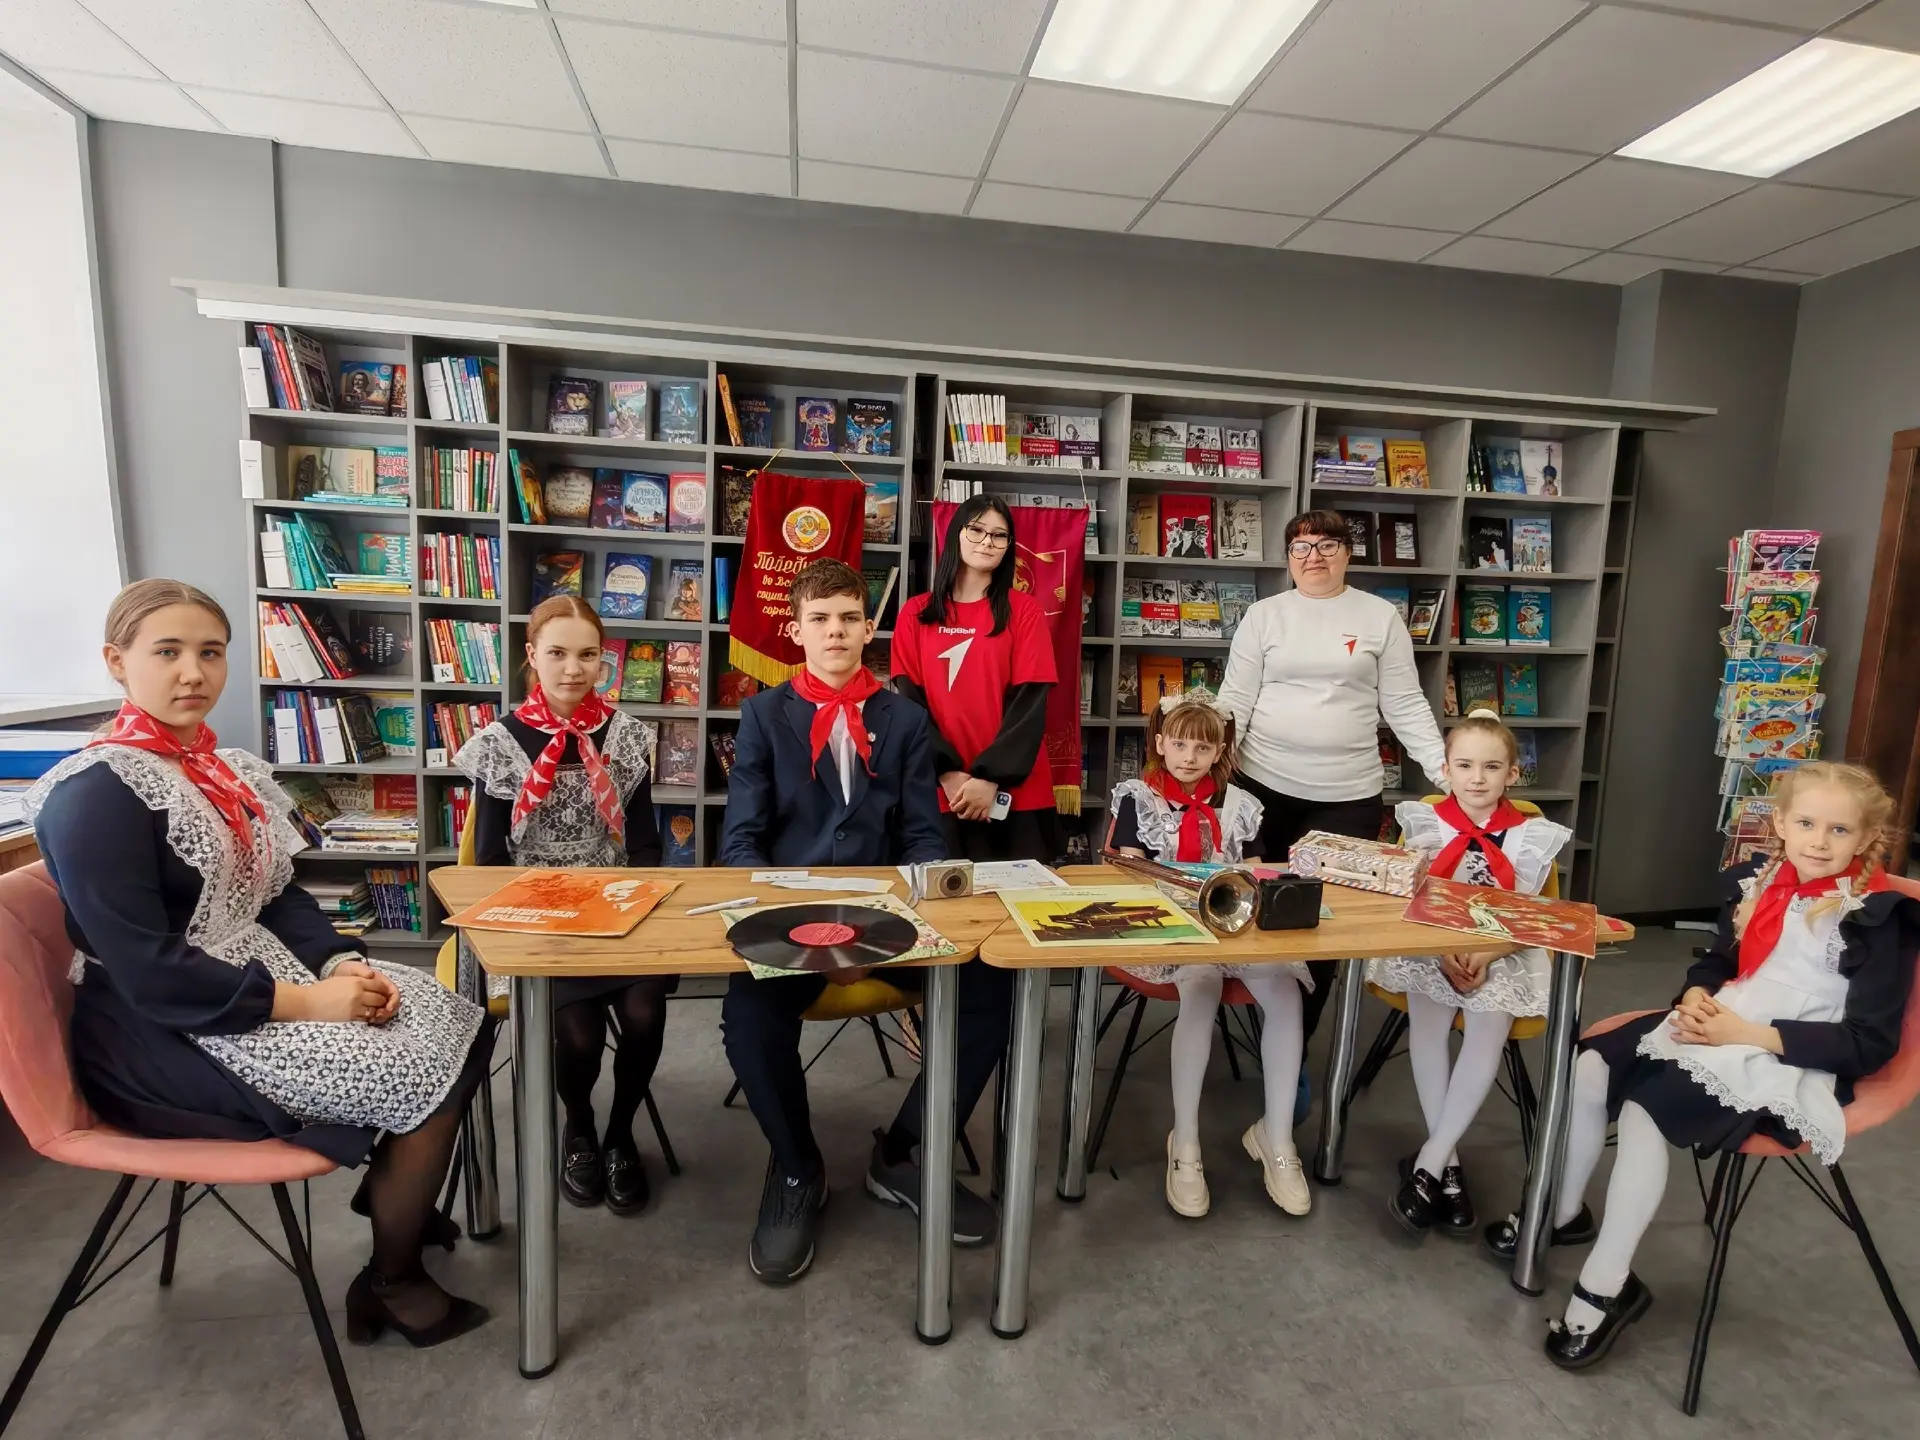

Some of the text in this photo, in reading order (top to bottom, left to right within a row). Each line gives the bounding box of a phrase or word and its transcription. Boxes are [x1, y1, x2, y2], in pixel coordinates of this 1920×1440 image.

[1751, 595, 1773, 604] ВОТ!
[762, 605, 794, 617] сорев
[777, 621, 793, 638] 19
[938, 626, 976, 636] Первые
[440, 668, 450, 678] К
[432, 752, 442, 763] Л
